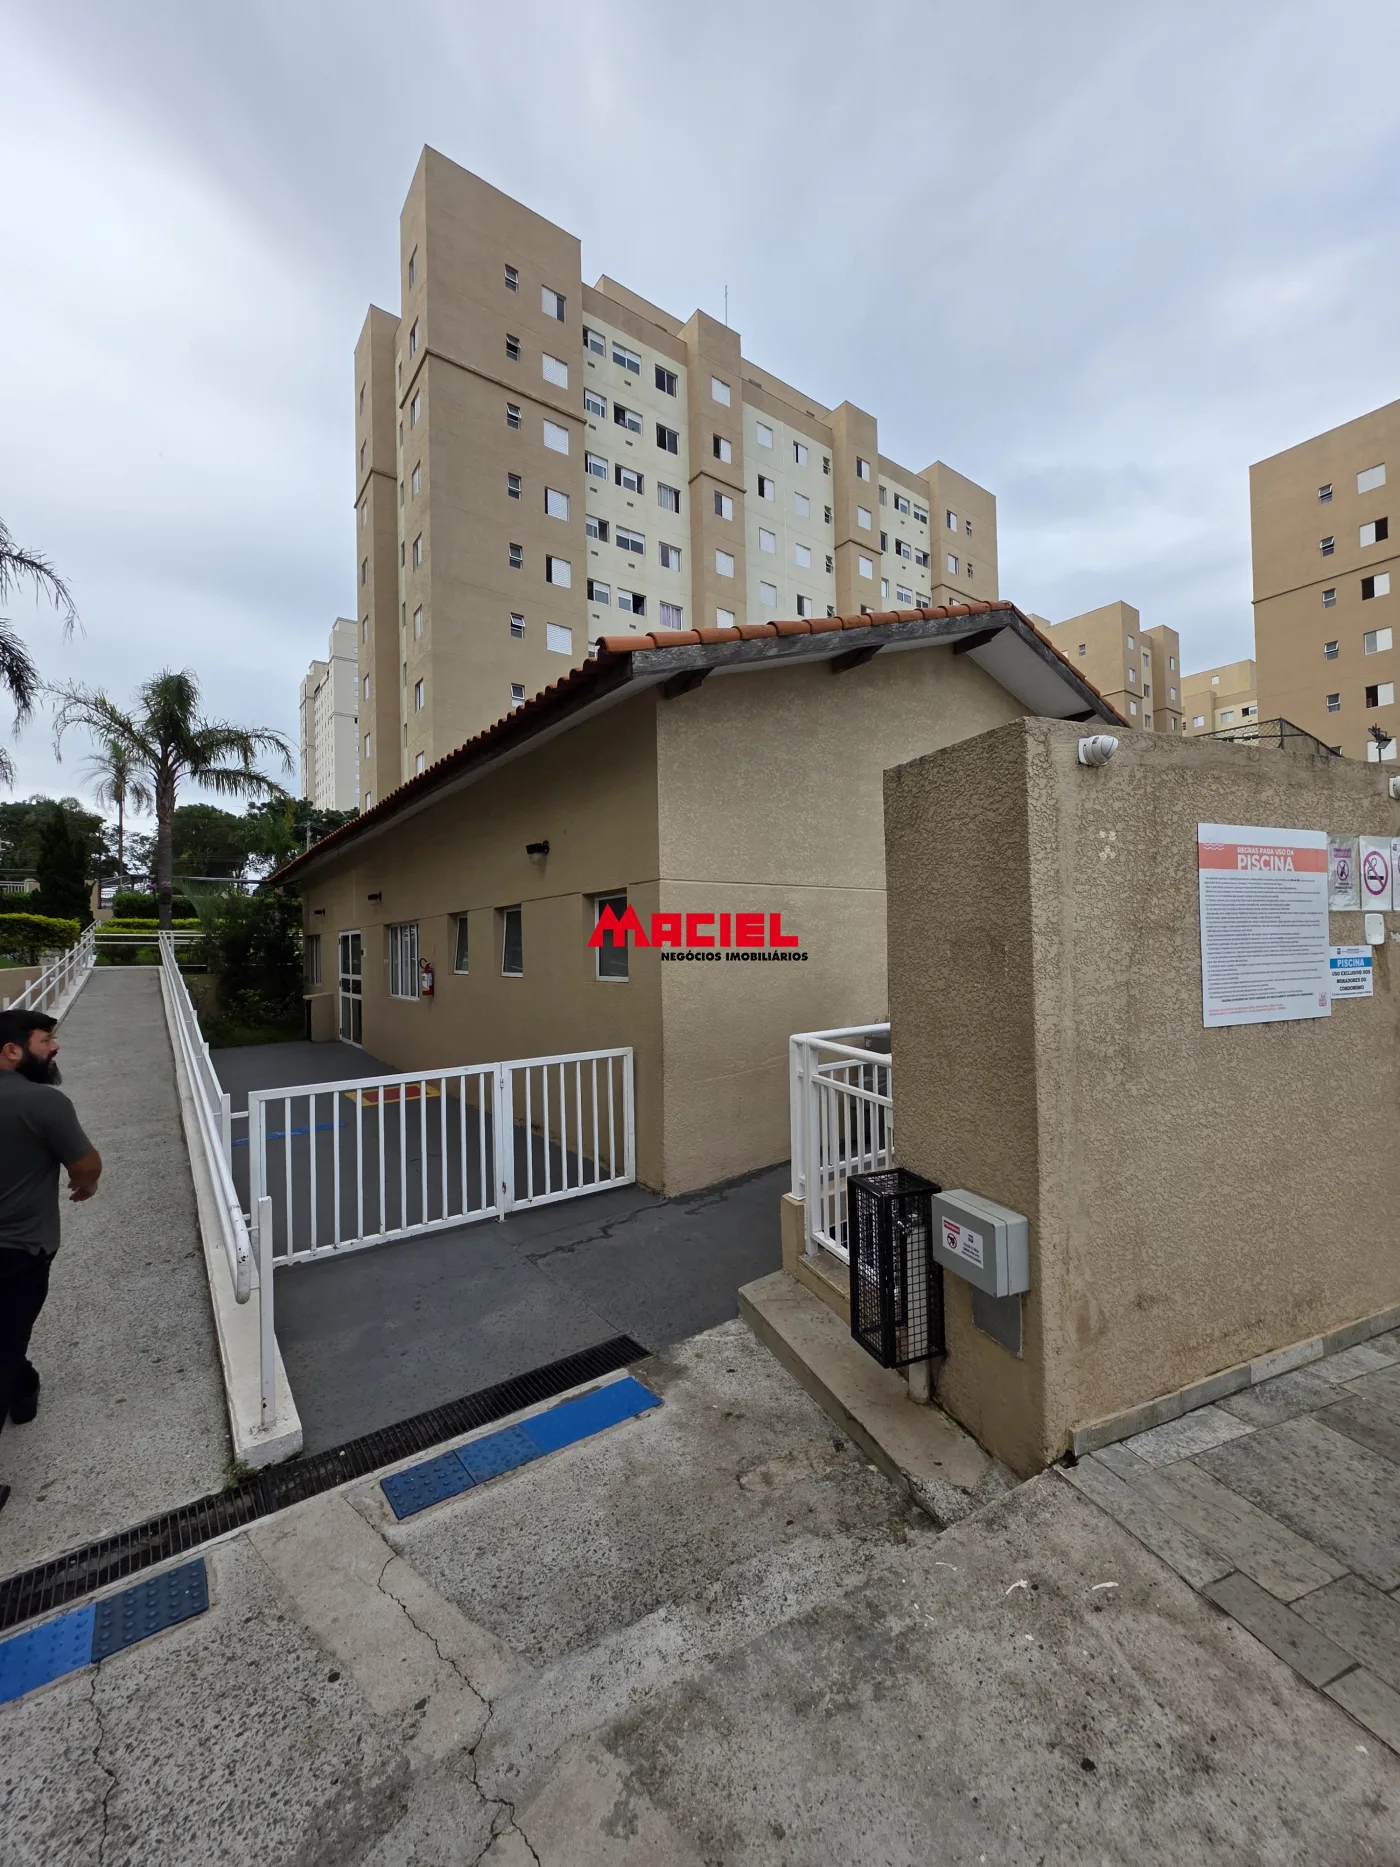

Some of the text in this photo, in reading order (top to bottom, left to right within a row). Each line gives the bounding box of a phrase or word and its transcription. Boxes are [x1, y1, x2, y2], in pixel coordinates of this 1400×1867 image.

[1237, 846, 1259, 854] REGRAS
[1259, 847, 1275, 855] PARA
[1237, 854, 1295, 872] PISCINA
[1337, 958, 1364, 967] PISCINA
